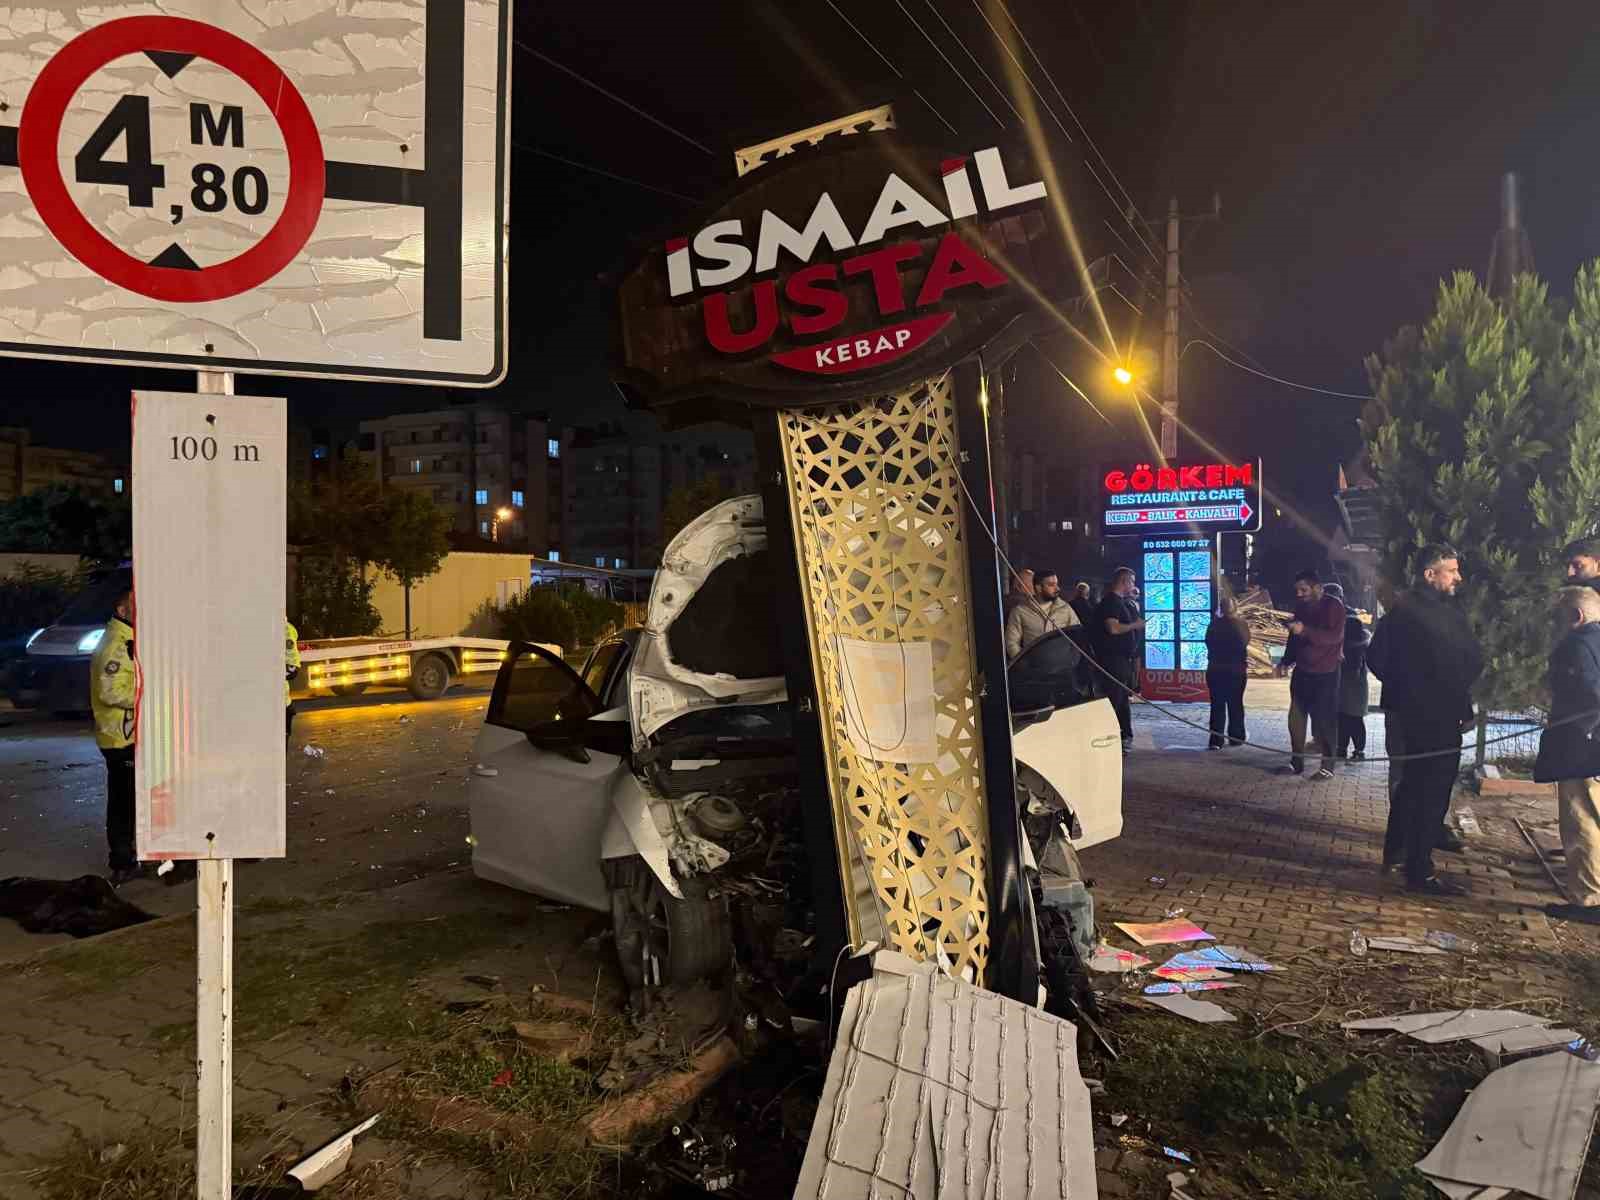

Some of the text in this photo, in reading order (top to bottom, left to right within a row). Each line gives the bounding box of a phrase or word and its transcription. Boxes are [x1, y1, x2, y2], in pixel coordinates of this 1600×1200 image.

[190, 102, 244, 148] M
[75, 94, 269, 225] 4,80
[704, 232, 1008, 353] USTA
[815, 329, 912, 369] KEBAP
[170, 435, 260, 462] 100 m
[1105, 464, 1252, 491] GÖRKEM
[1146, 671, 1173, 682] OTO
